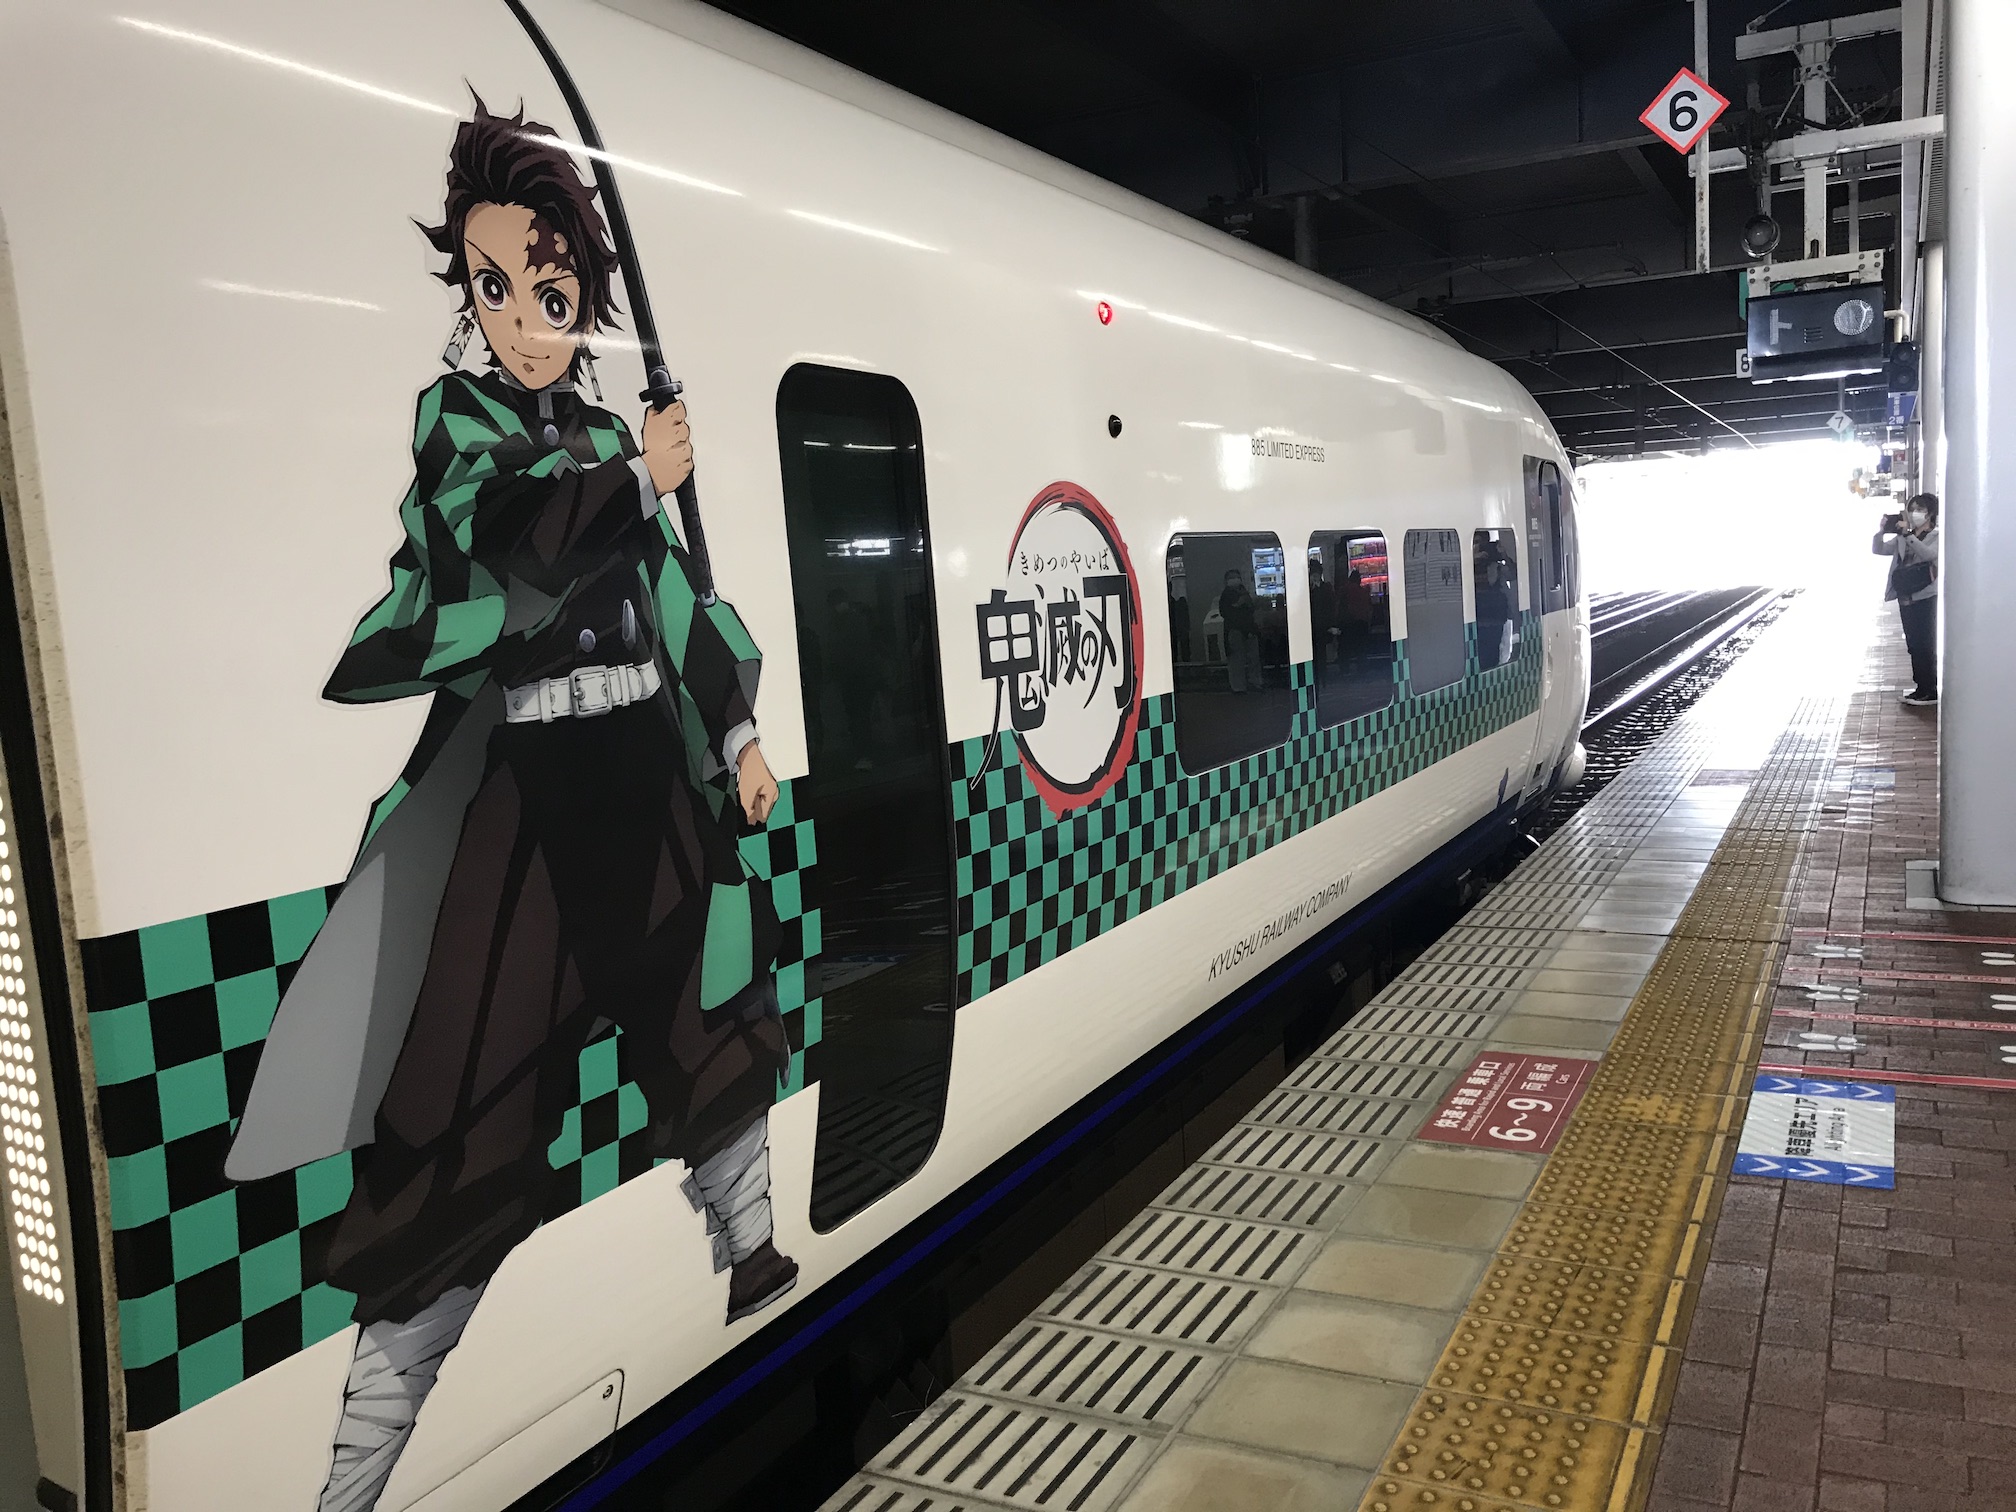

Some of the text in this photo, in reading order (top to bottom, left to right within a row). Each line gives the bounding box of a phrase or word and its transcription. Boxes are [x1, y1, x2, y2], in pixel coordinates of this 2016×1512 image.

[1669, 90, 1698, 132] 6
[1834, 416, 1844, 429] 7
[1888, 415, 1905, 425] 2番
[1251, 438, 1326, 463] 885 LIMITED EXPRESS
[1020, 548, 1110, 576] きめつのやいば
[970, 574, 1134, 790] 鬼滅の刃
[1208, 872, 1353, 982] KYUSHU RAILWAY COMPANY
[1466, 1061, 1502, 1085] 乗車口
[1520, 1063, 1558, 1091] 両編成
[1555, 1074, 1570, 1084] Cars
[1828, 1107, 1846, 1122] Ara
